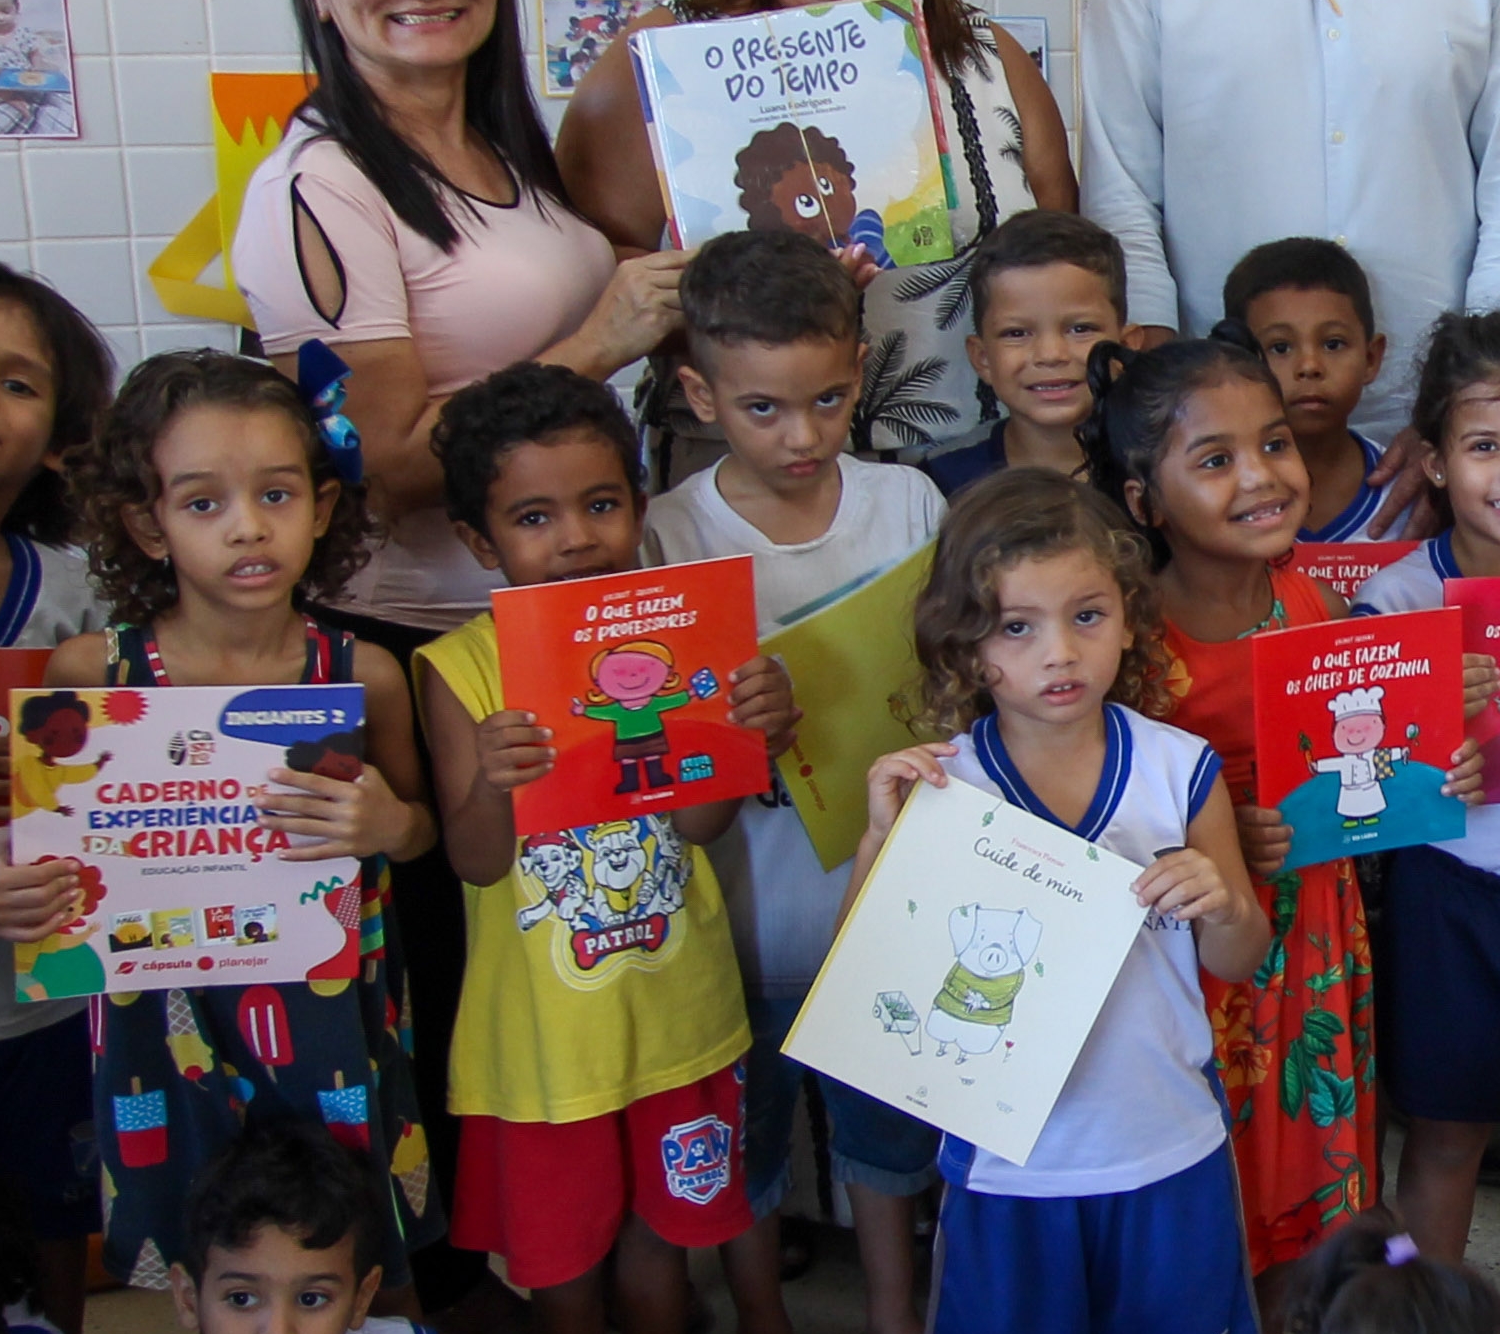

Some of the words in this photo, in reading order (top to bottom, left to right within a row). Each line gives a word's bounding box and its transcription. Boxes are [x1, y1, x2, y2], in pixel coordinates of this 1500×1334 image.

[705, 47, 722, 69] O
[732, 19, 866, 71] PRESENTE
[725, 74, 764, 102] DO
[771, 60, 858, 95] TEMPO
[586, 605, 598, 622] O
[602, 604, 633, 620] QUE
[637, 594, 684, 615] FAZEM
[574, 627, 592, 642] OS
[598, 611, 698, 642] PROFESSORES
[1312, 655, 1320, 670] O
[1324, 651, 1350, 668] QUE
[1355, 641, 1401, 665] FAZEM
[1286, 680, 1300, 695] OS
[1304, 670, 1343, 691] CHEFS
[1349, 668, 1366, 683] DE
[1369, 659, 1431, 679] COZINHA
[96, 779, 241, 804] CADERNO
[88, 802, 276, 829] EXPERIÊNCIA
[130, 827, 291, 862] CRIANÇA
[974, 837, 1018, 872] Cuide
[1022, 863, 1042, 883] de
[1045, 877, 1084, 903] mim
[585, 922, 655, 955] PATROL
[142, 958, 192, 971] cápsula
[219, 956, 269, 970] planejar
[662, 1126, 732, 1171] PAW
[677, 1168, 725, 1189] PATROL
